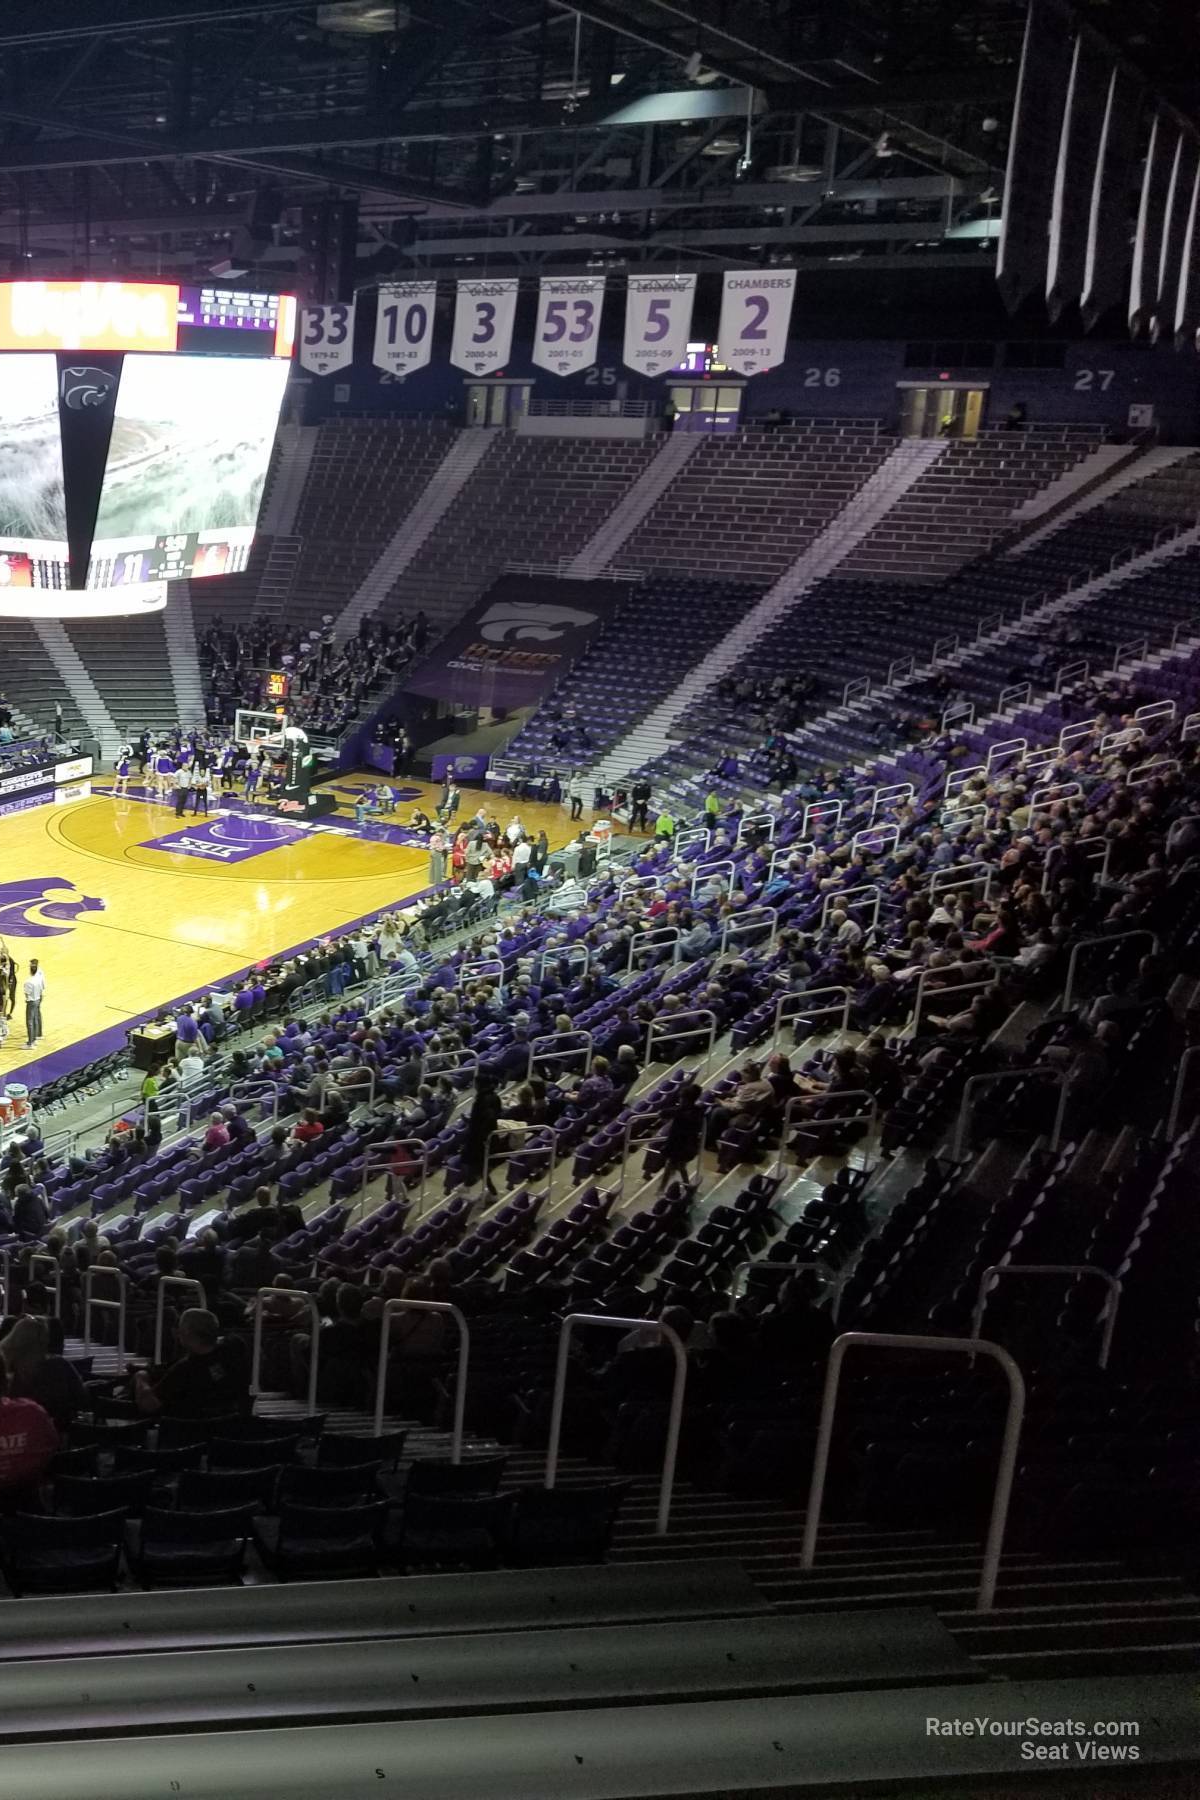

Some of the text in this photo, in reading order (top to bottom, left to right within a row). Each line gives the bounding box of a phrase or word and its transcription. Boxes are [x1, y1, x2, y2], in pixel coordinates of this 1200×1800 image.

[727, 278, 792, 290] CHAMBERS
[304, 307, 348, 345] 33
[383, 304, 428, 344] 10
[472, 302, 496, 343] 3
[542, 300, 594, 342] 53
[643, 299, 671, 342] 5
[740, 295, 769, 340] 2
[732, 348, 770, 357] 2009-13
[584, 368, 617, 385] 25
[804, 368, 841, 387] 26
[1074, 369, 1116, 391] 27
[208, 809, 361, 836] K-STATE
